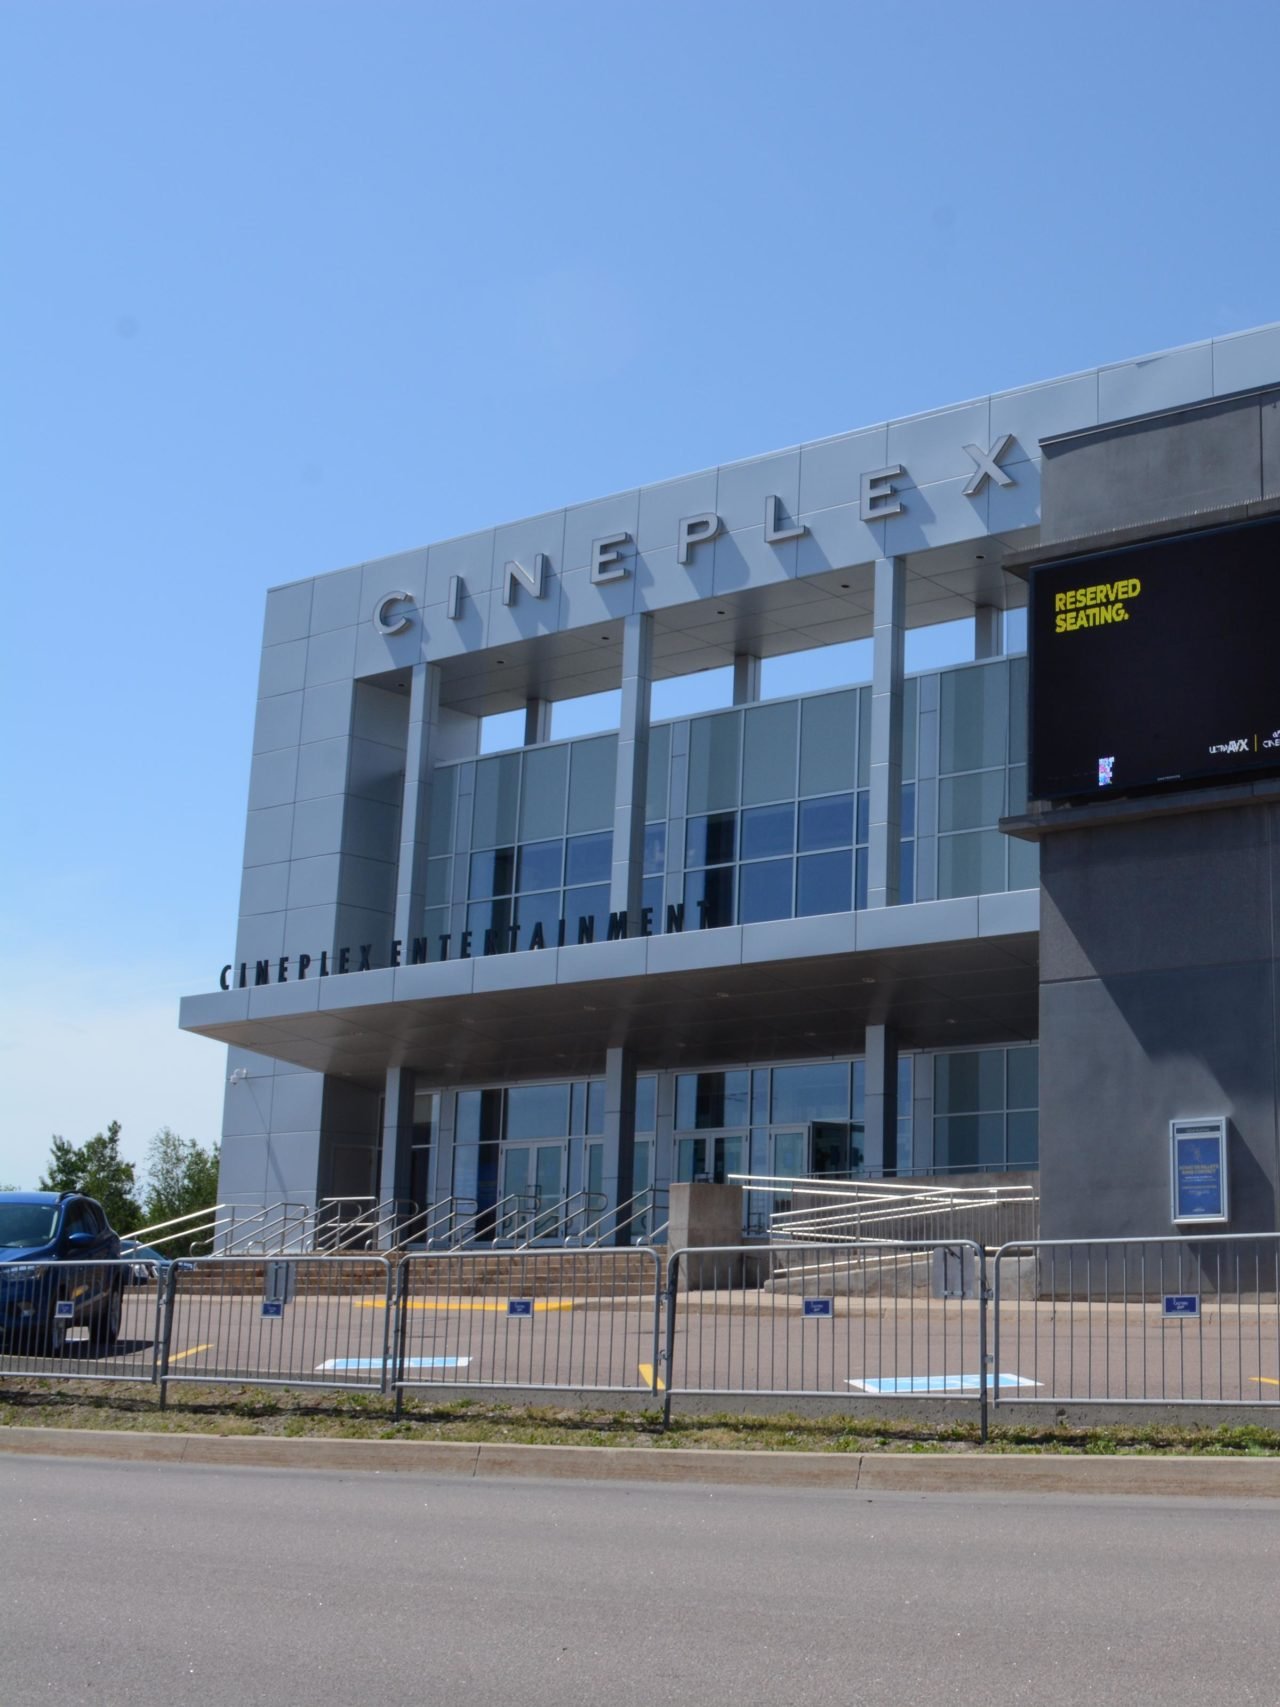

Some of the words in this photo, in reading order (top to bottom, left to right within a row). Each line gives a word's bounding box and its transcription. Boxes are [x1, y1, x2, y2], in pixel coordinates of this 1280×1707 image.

[373, 433, 1014, 636] CINEPLEX
[1055, 578, 1141, 611] RESERVED
[1055, 602, 1130, 633] SEATING.
[219, 943, 372, 990] CINEPLEX
[390, 899, 711, 967] ENTERTAINMENT
